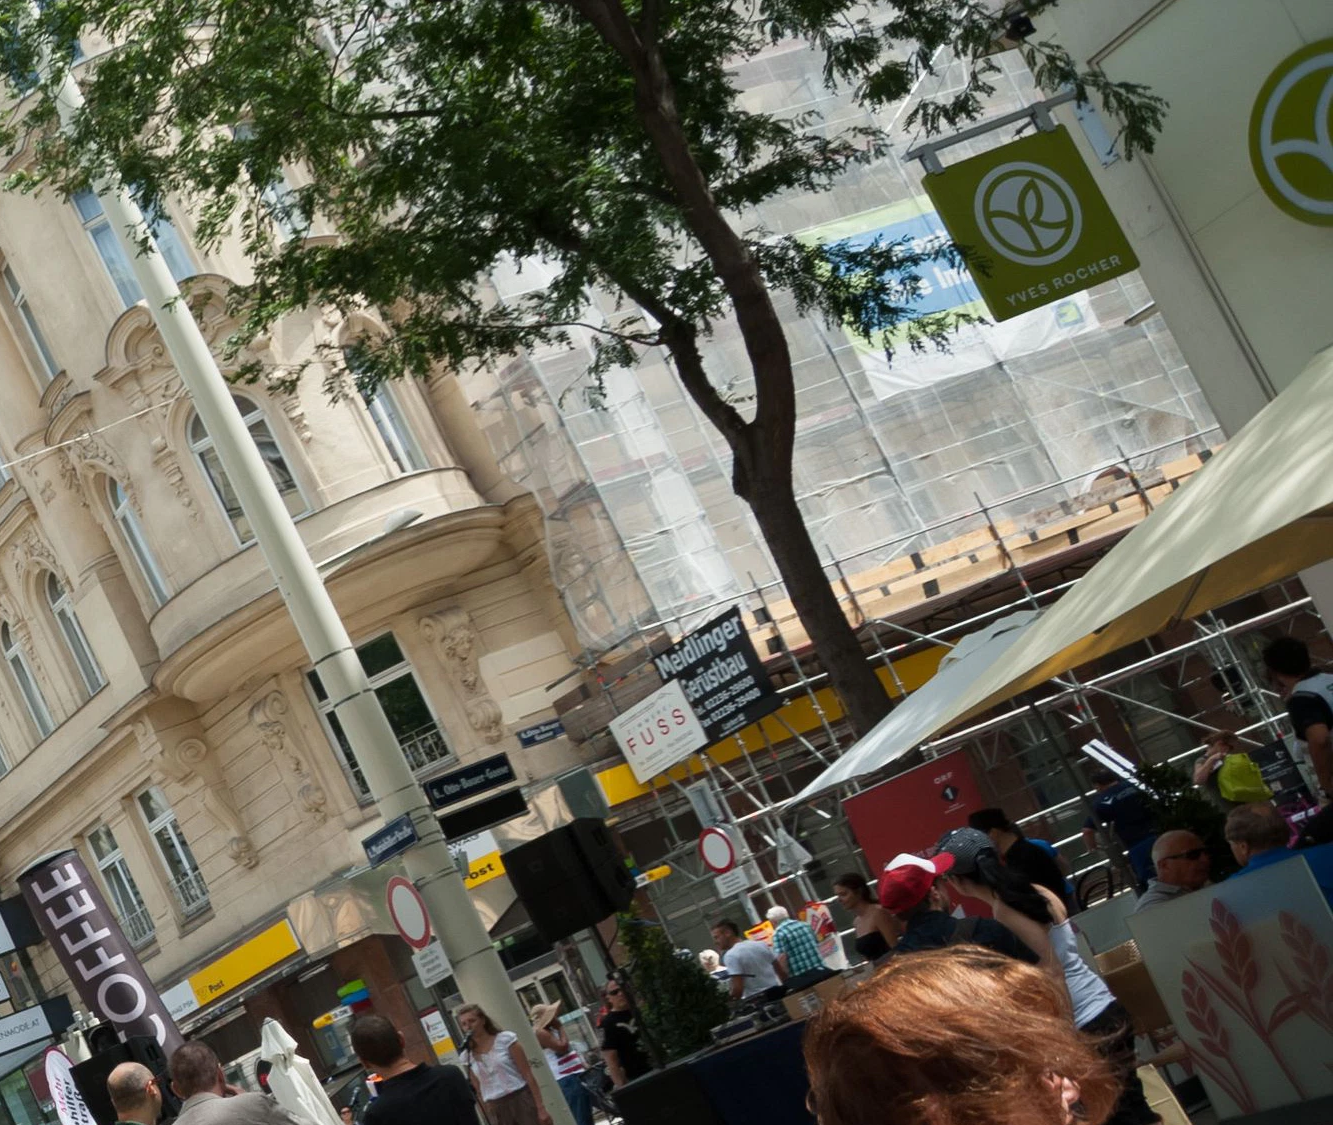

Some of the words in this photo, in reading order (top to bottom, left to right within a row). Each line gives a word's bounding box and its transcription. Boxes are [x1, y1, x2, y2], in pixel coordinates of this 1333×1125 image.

[1006, 282, 1050, 306] YVES
[1052, 255, 1122, 290] ROCHER
[655, 615, 741, 679] Meidlinger
[626, 708, 686, 755] FUSS
[933, 771, 954, 785] ORF
[464, 862, 495, 881] ost
[208, 980, 225, 995] Post
